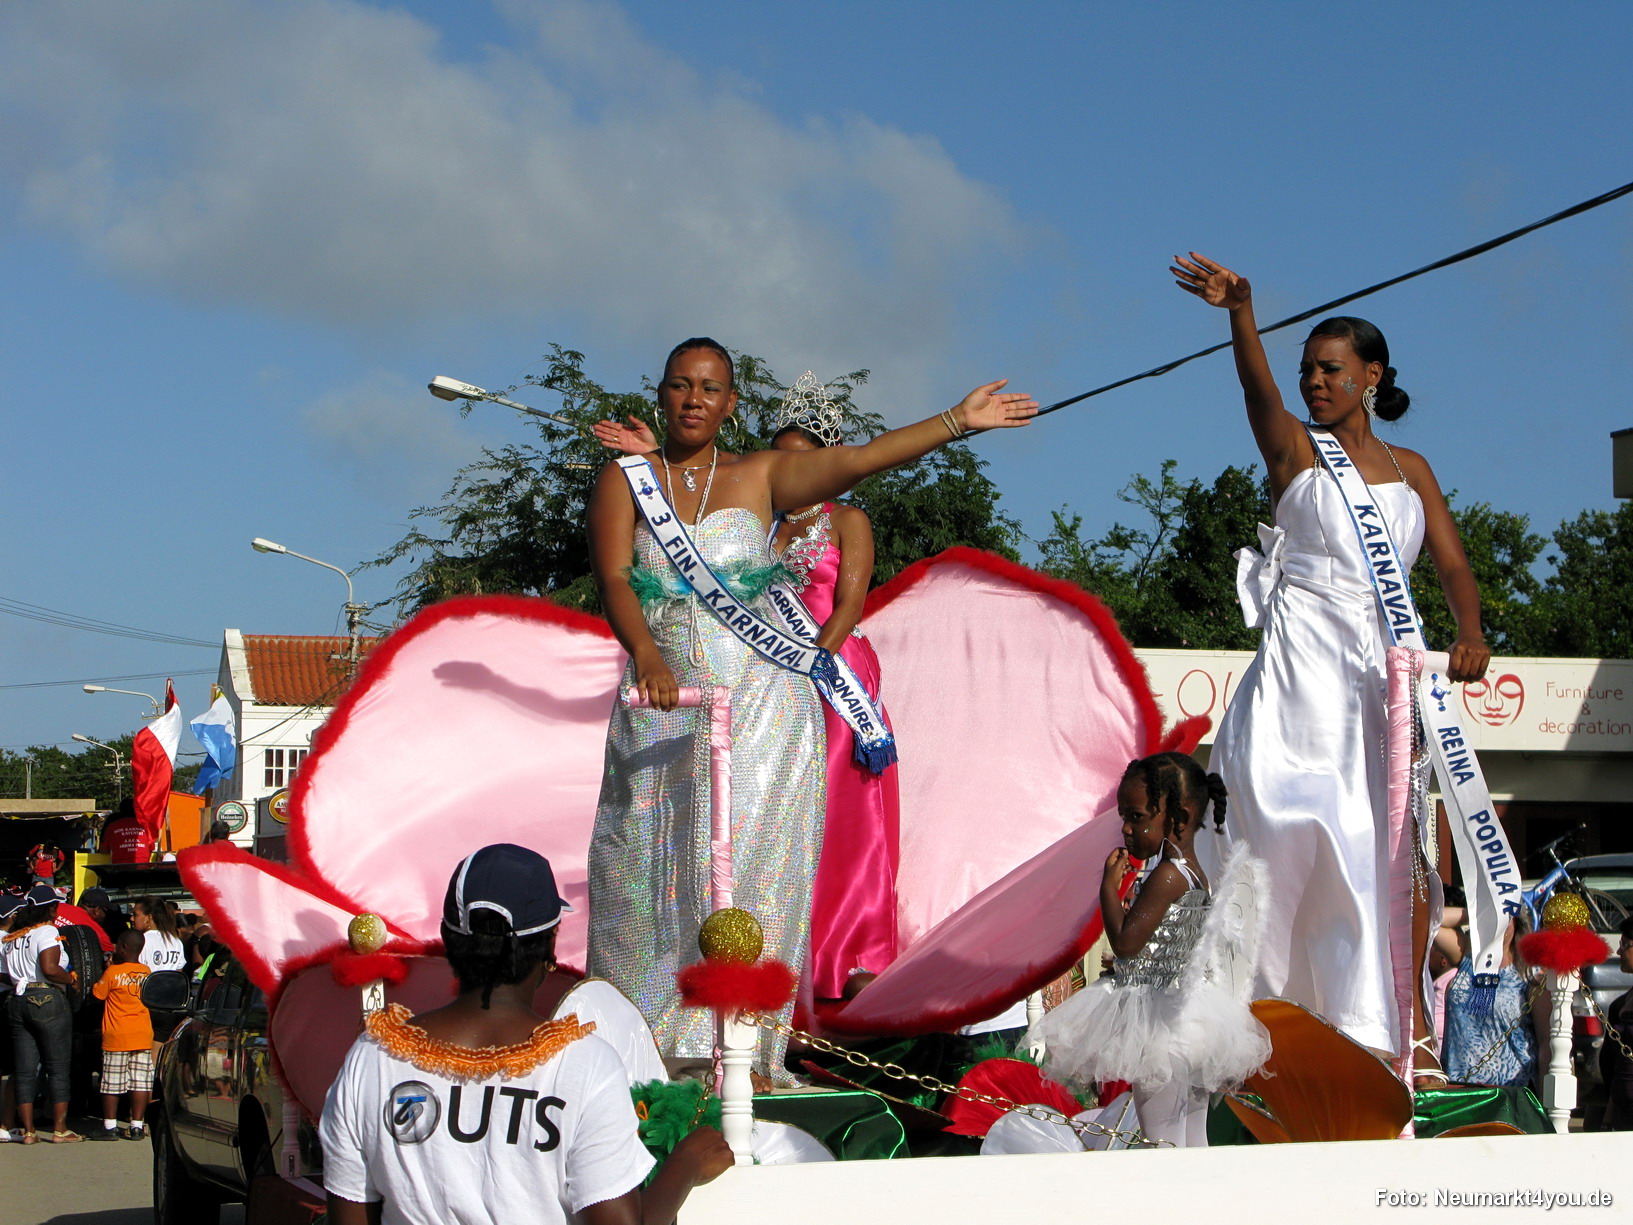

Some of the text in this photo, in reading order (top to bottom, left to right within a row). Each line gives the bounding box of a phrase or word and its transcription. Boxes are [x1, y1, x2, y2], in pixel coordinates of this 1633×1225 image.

[1316, 438, 1415, 641] FIN. KARNAVAL
[651, 512, 806, 668] 3 FIN. KARNAVAL
[768, 585, 815, 643] ARNAVA
[834, 675, 875, 734] ONAIRE
[1546, 681, 1623, 700] Furniture
[1581, 702, 1591, 716] &
[1538, 717, 1631, 735] decoration
[1437, 726, 1522, 918] REINA POPULAR
[447, 1085, 567, 1153] UTS
